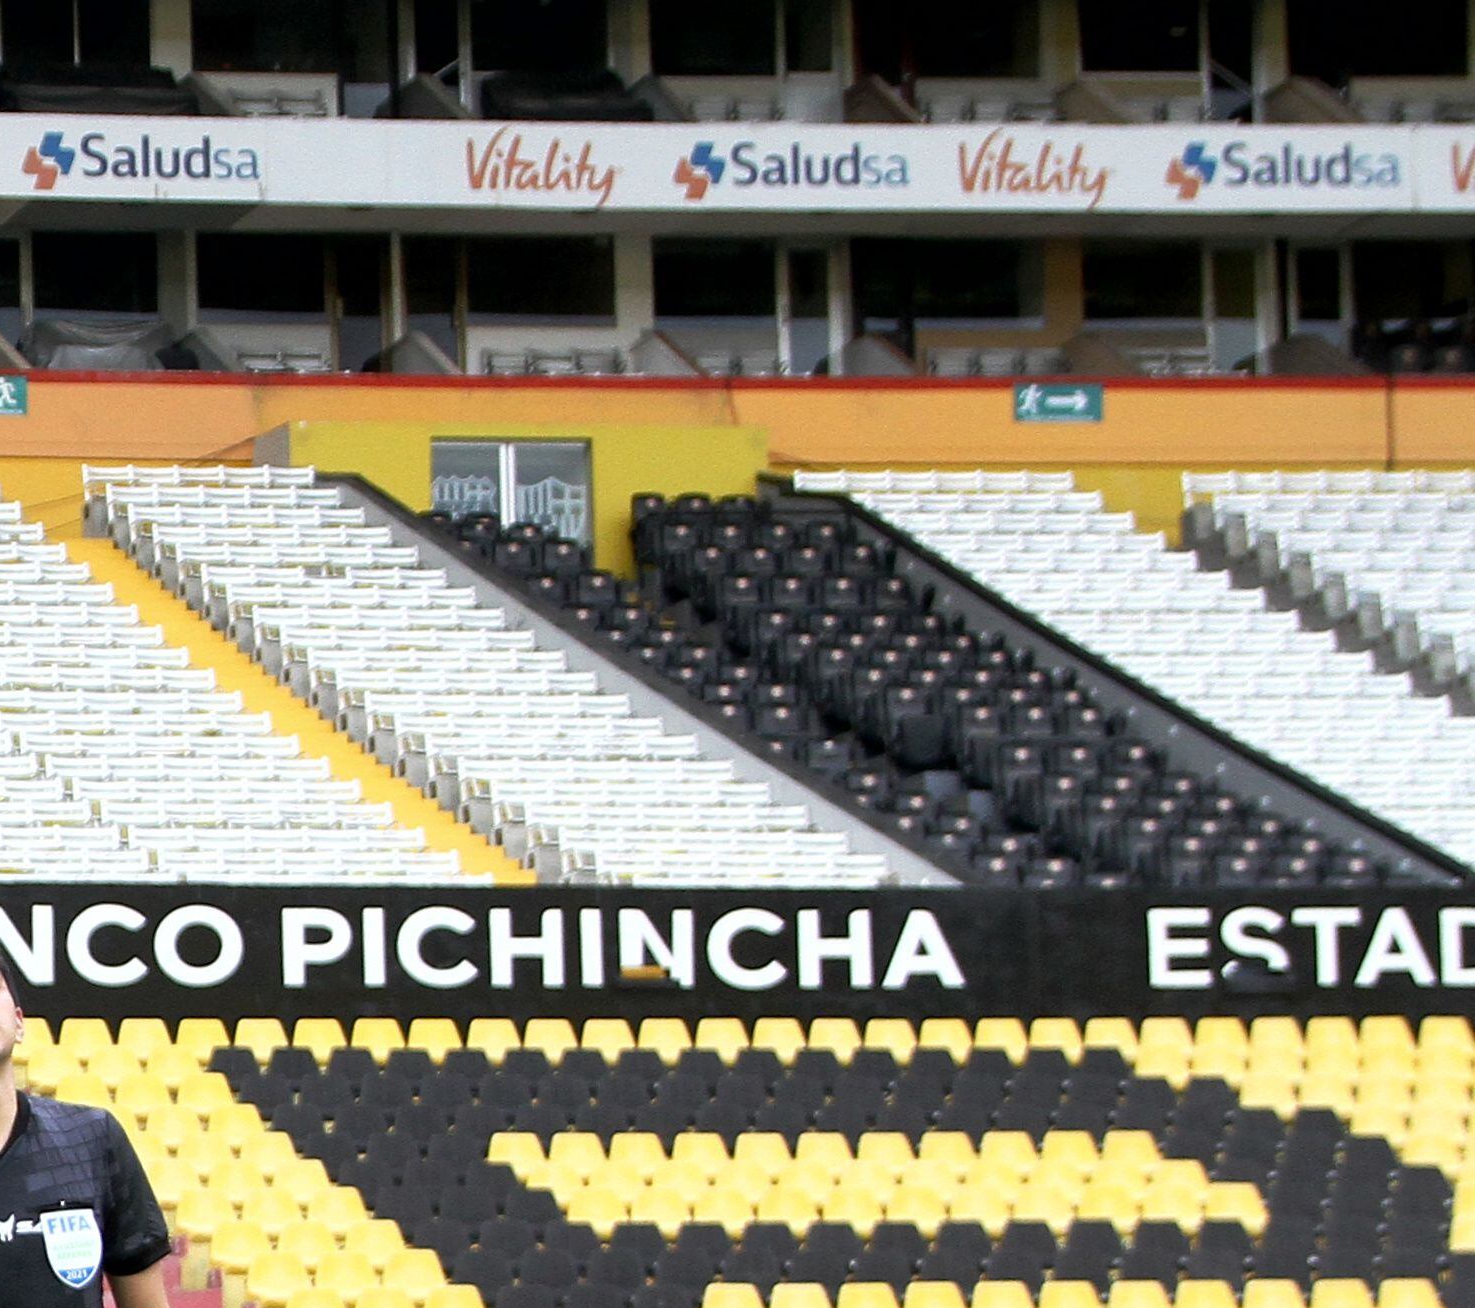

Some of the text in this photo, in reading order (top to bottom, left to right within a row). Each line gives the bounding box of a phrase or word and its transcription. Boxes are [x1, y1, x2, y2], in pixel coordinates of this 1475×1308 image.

[80, 133, 260, 180] Saludsa
[465, 126, 615, 206] Vitality
[731, 142, 909, 187] Saludsa
[958, 128, 1107, 209] Vitality
[1221, 140, 1400, 186] Saludsa
[281, 906, 965, 989] PICHINCHA
[46, 1215, 91, 1235] FIFA
[66, 1268, 88, 1281] 2021
